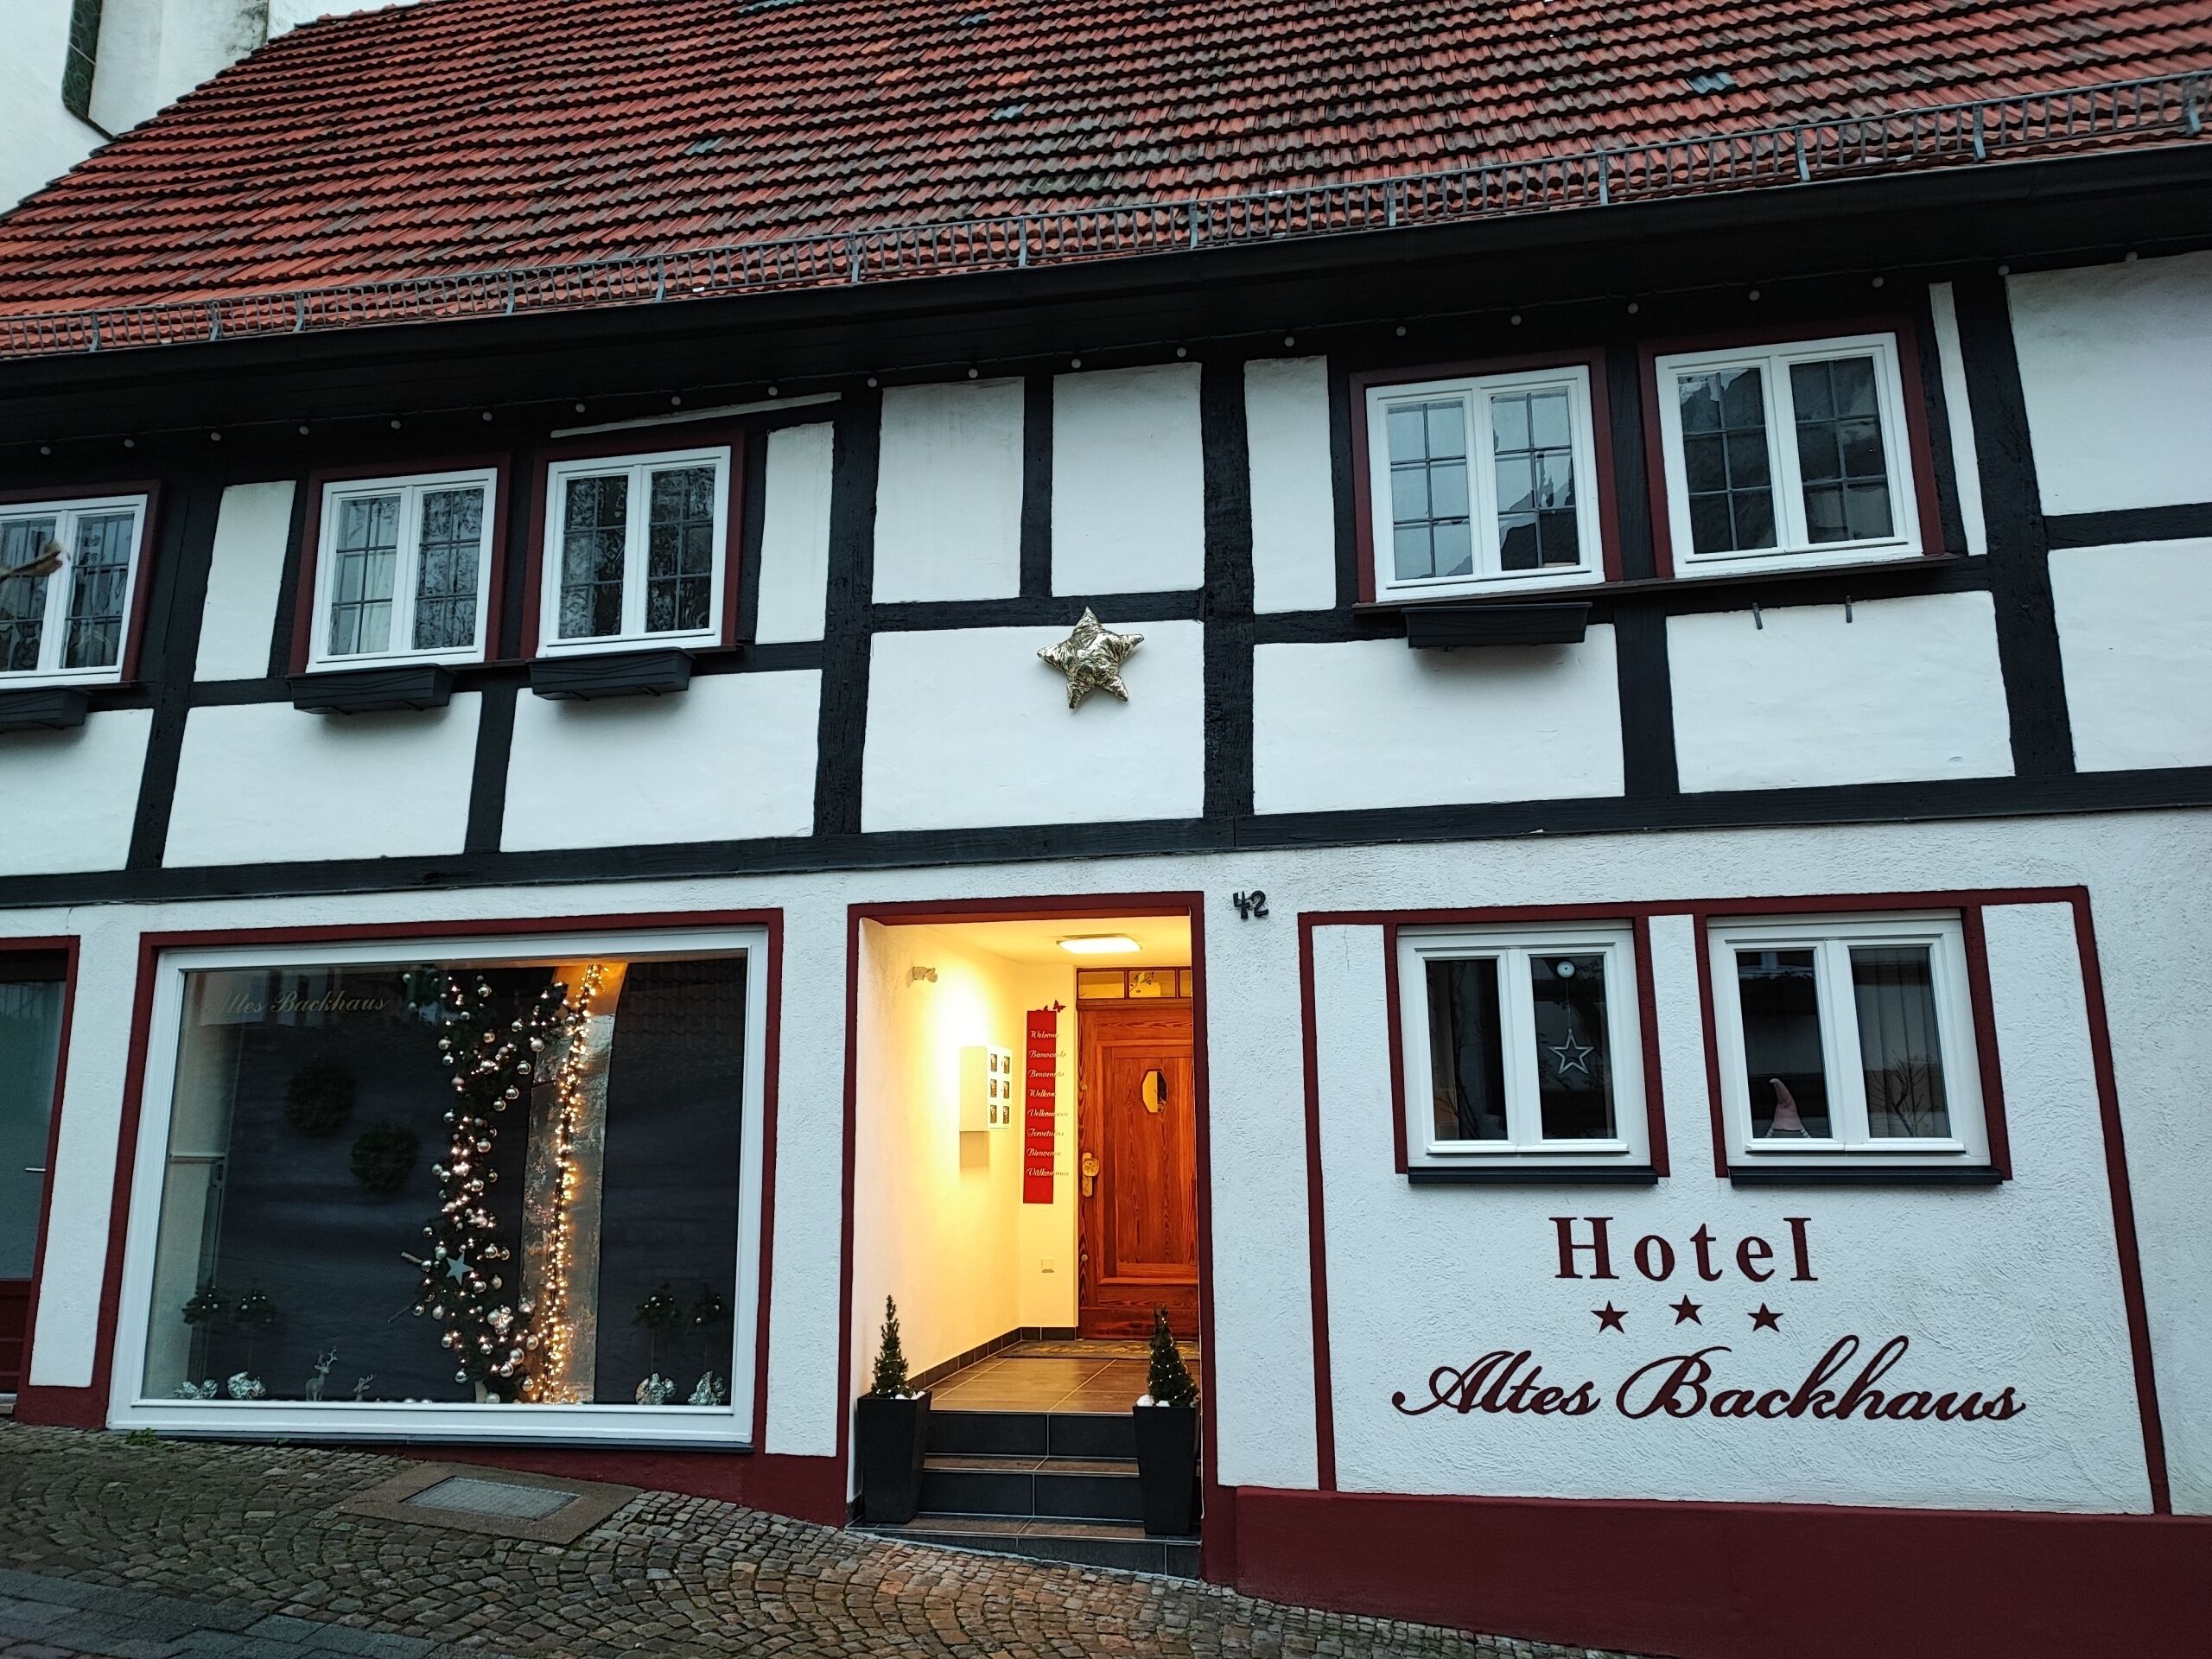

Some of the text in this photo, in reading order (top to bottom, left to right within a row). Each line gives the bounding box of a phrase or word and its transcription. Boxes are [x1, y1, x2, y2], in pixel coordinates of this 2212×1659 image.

[1233, 891, 1268, 918] 42
[270, 990, 389, 1014] Backhaus
[1031, 1030, 1059, 1039] Welcome
[1029, 1089, 1057, 1097] Welkom
[1548, 1216, 1818, 1281] Hotel
[1391, 1335, 2027, 1420] Altes Backhaus
